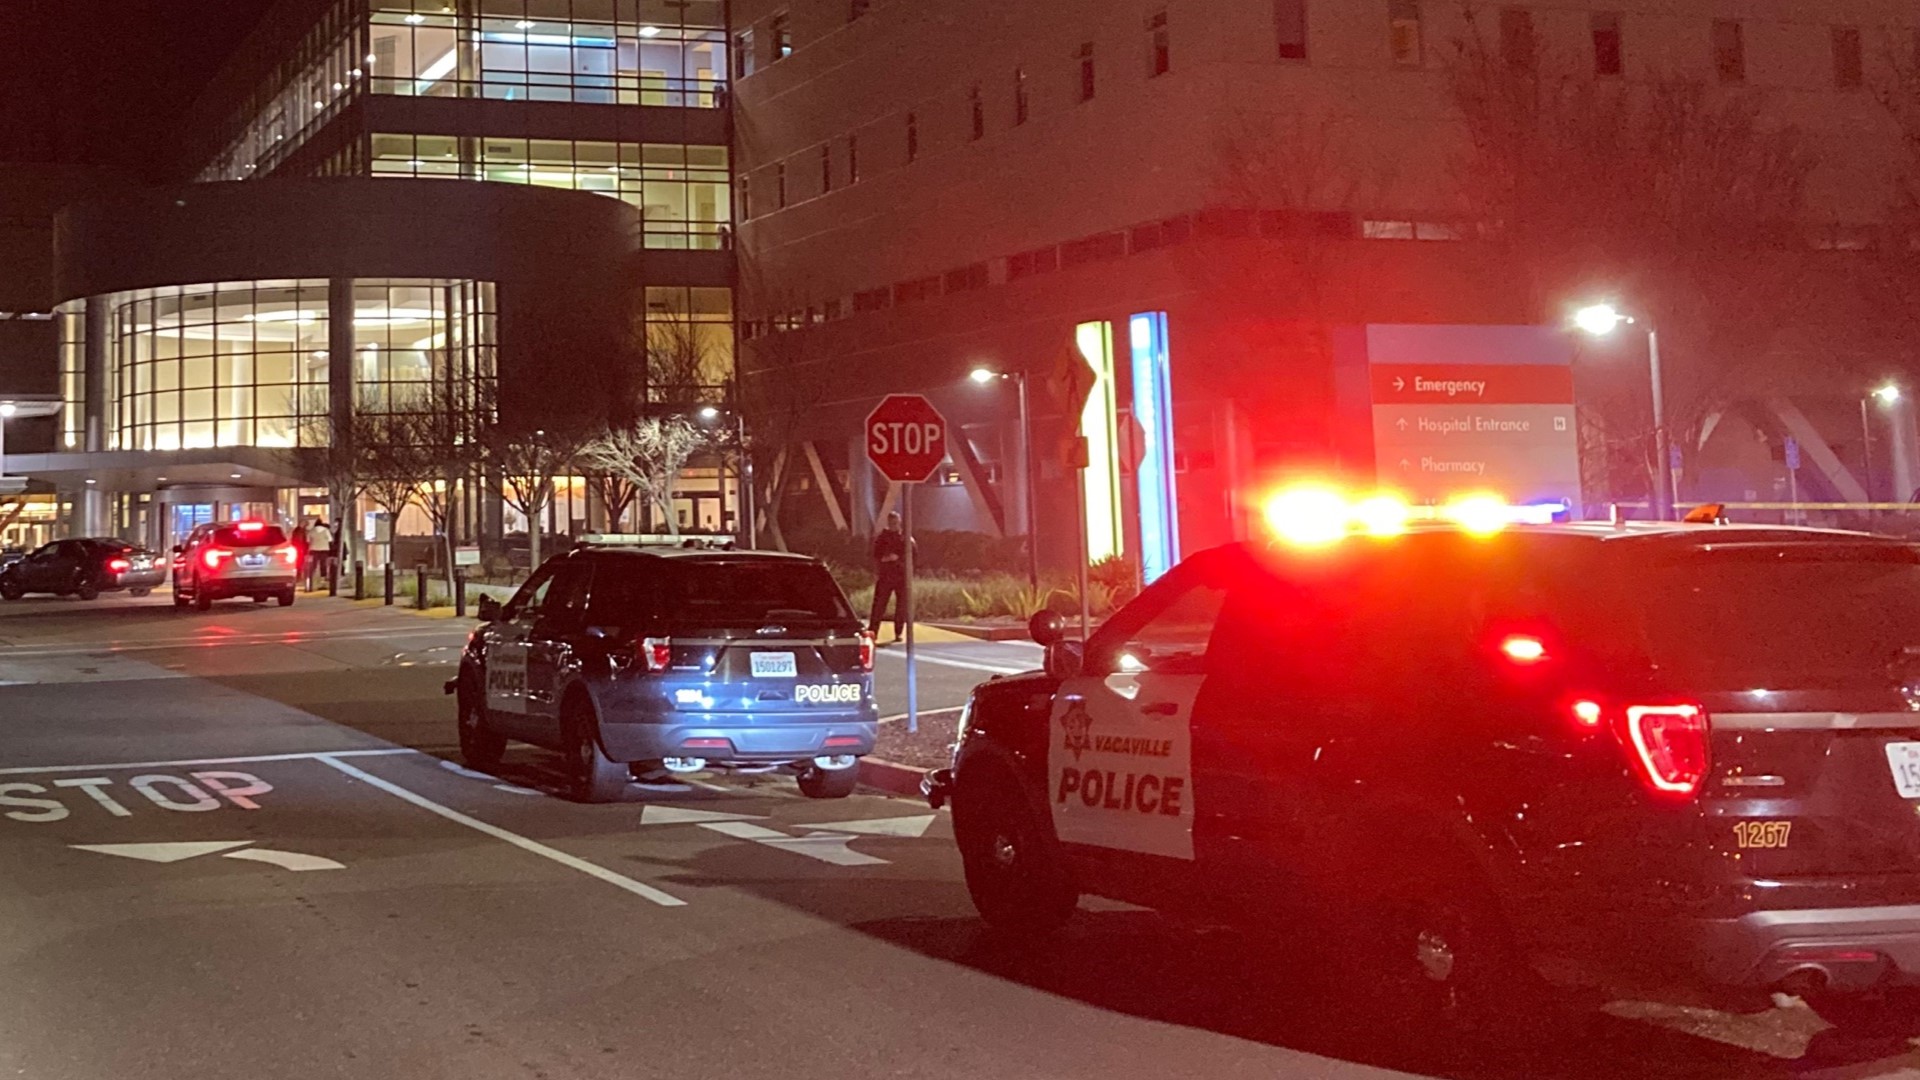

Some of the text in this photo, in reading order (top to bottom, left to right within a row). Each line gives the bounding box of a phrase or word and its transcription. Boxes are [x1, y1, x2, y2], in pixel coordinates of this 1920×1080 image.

[1415, 376, 1485, 396] Emergency
[1418, 416, 1530, 435] Hospital Entrance
[872, 422, 940, 454] STOP
[1421, 456, 1485, 475] Pharmacy
[795, 683, 861, 702] POLICE
[1095, 735, 1172, 757] VACAVILLE
[0, 771, 274, 822] STOP
[1057, 767, 1184, 816] POLICE
[1733, 821, 1791, 847] 1267
